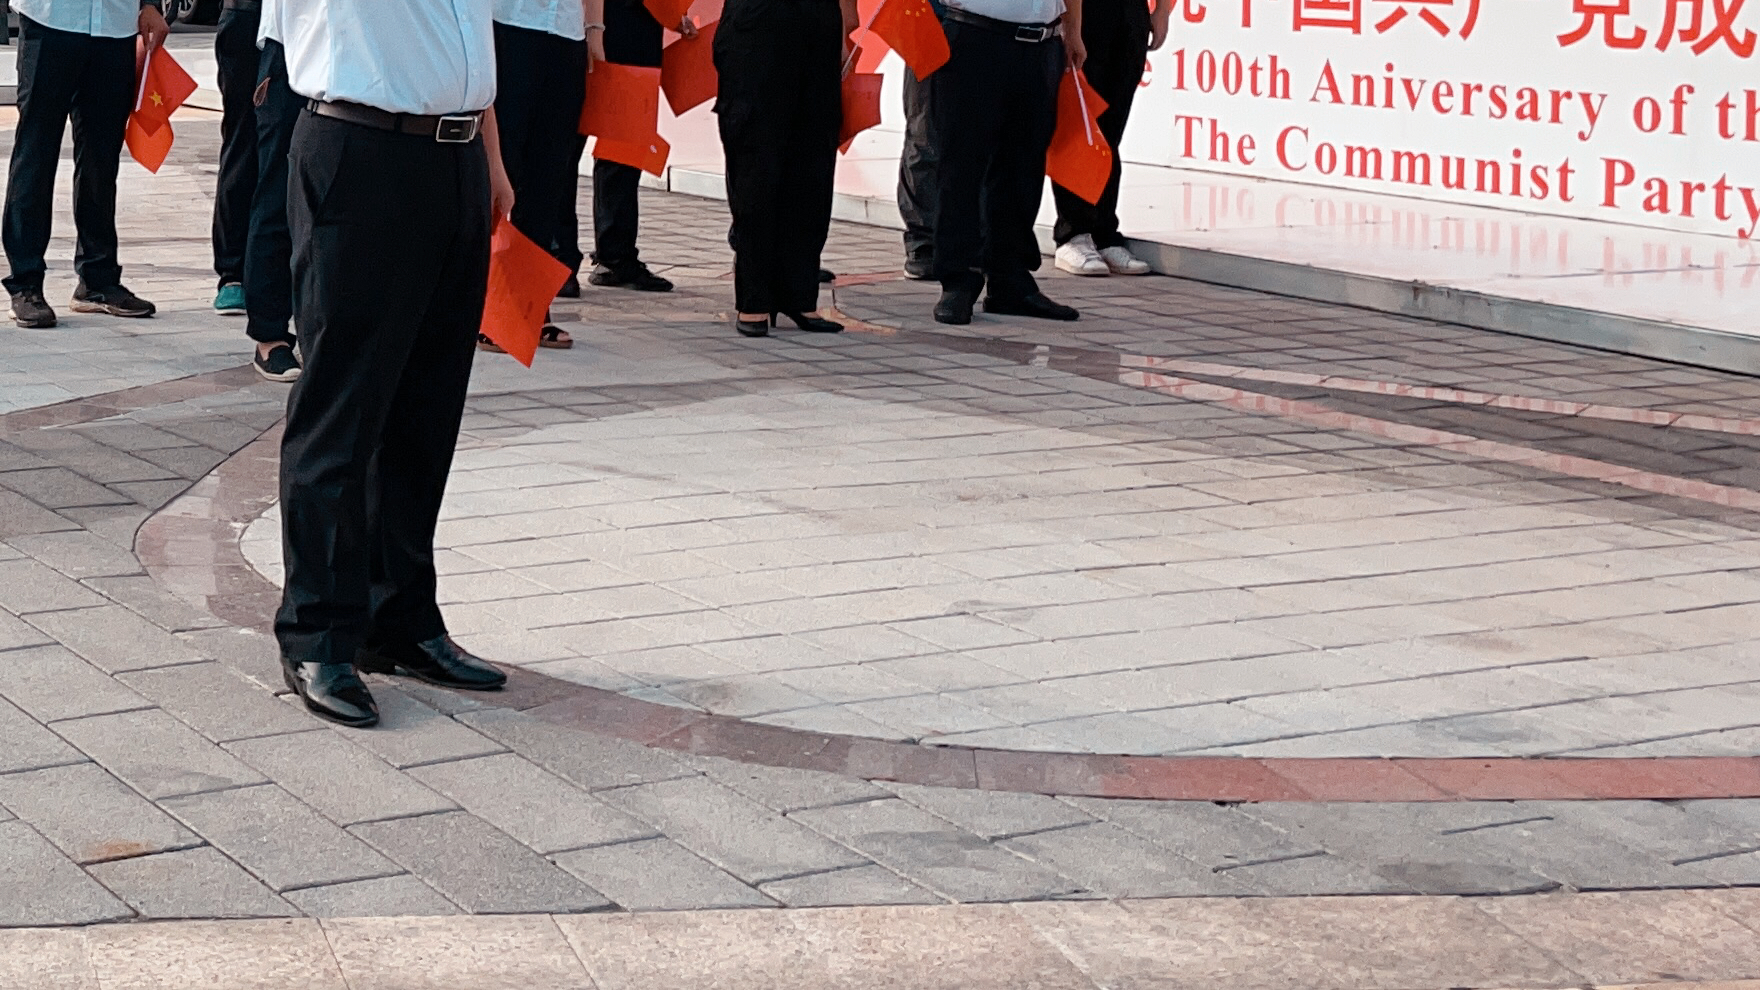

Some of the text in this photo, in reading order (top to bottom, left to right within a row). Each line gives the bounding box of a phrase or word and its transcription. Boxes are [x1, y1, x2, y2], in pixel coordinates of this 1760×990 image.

[1172, 48, 1292, 101] 100th
[1309, 57, 1608, 141] Aniversary
[1633, 84, 1695, 136] of
[1174, 114, 1760, 240] The Communist Party
